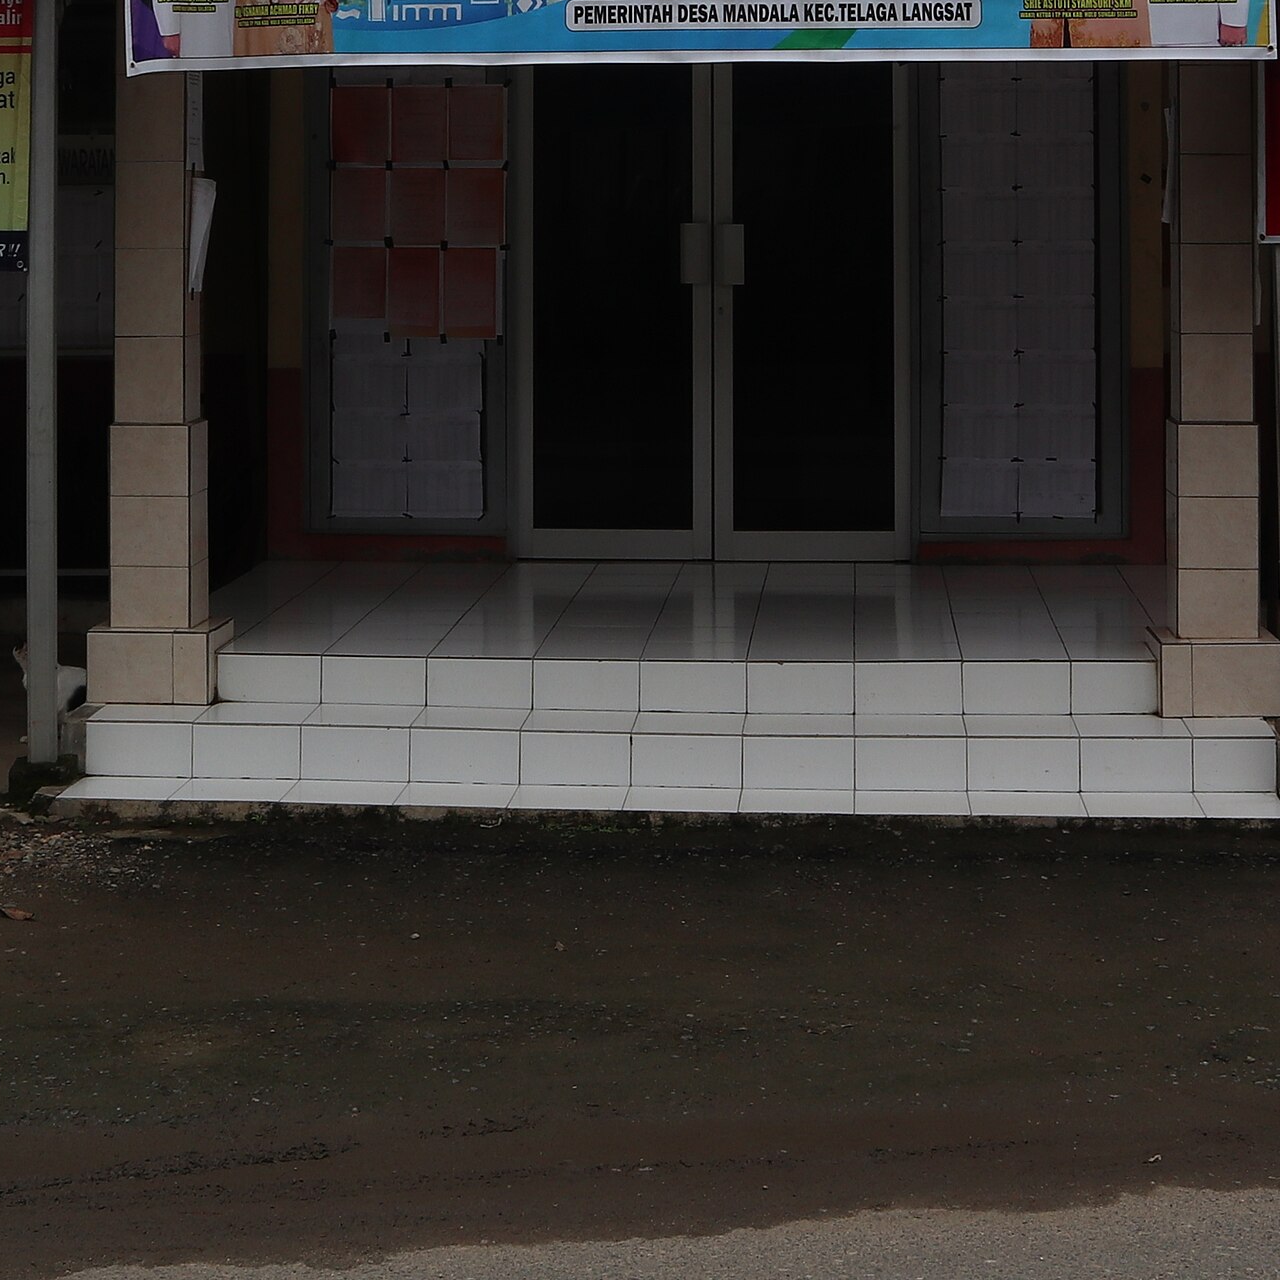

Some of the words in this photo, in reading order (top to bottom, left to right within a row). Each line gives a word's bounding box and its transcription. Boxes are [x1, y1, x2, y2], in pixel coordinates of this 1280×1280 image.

[574, 6, 672, 24] PEMERINTAH
[677, 5, 717, 24] DESA
[722, 4, 800, 23] MANDALA
[902, 3, 972, 22] LANGSAT
